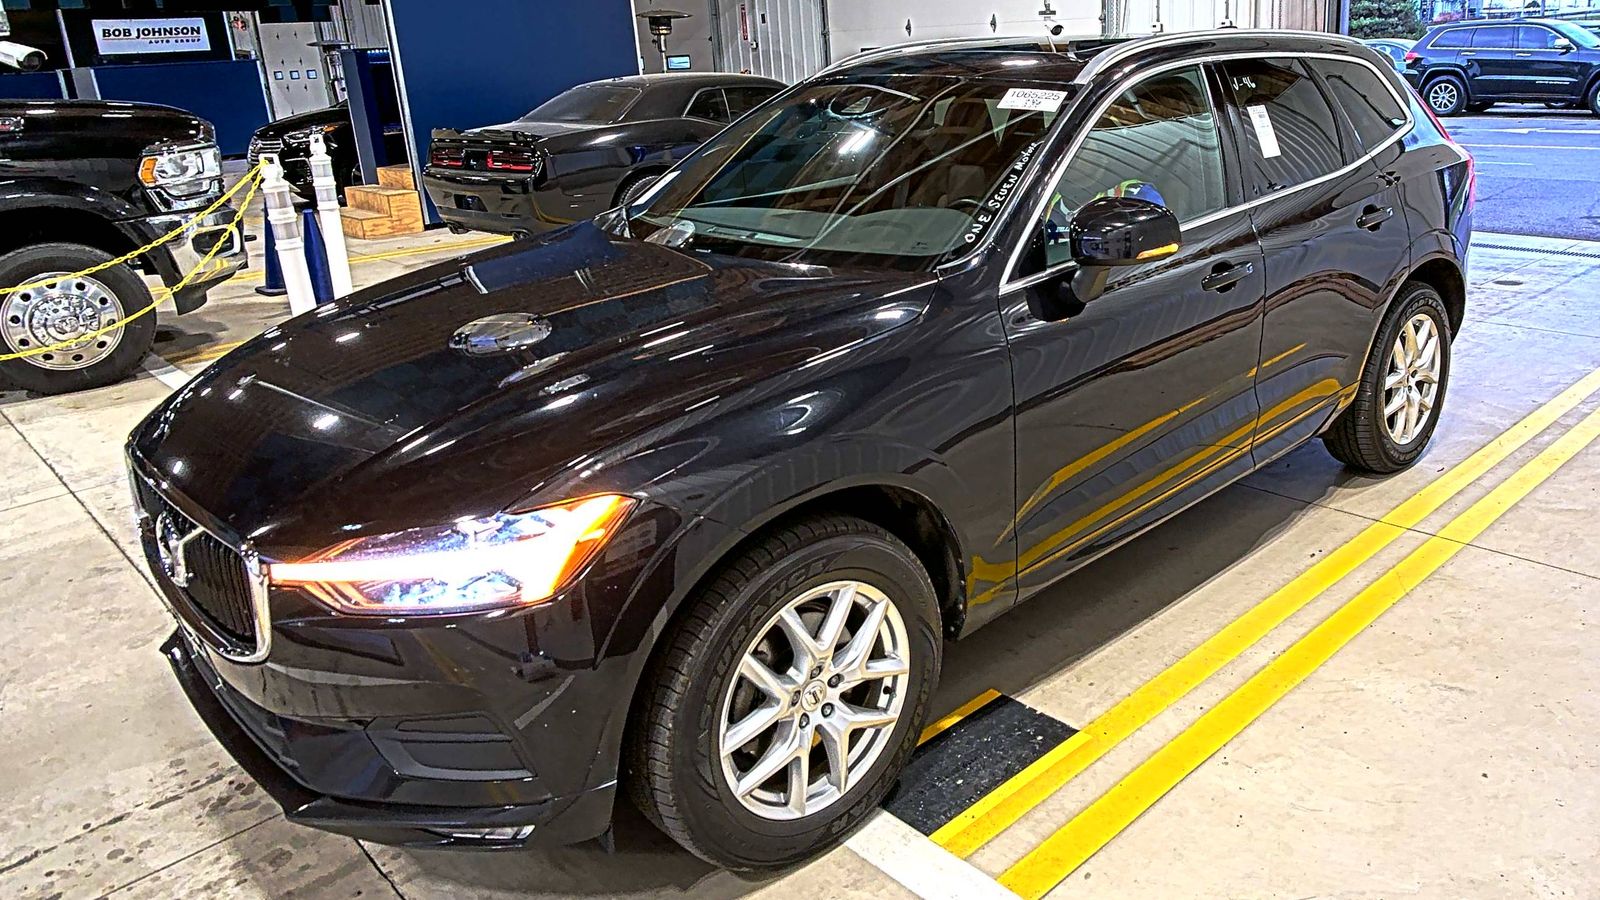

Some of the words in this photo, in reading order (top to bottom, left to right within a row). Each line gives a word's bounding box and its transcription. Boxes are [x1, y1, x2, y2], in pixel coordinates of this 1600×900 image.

[102, 28, 132, 38] BOB
[136, 26, 201, 39] JOHNSON
[965, 214, 992, 243] ONE
